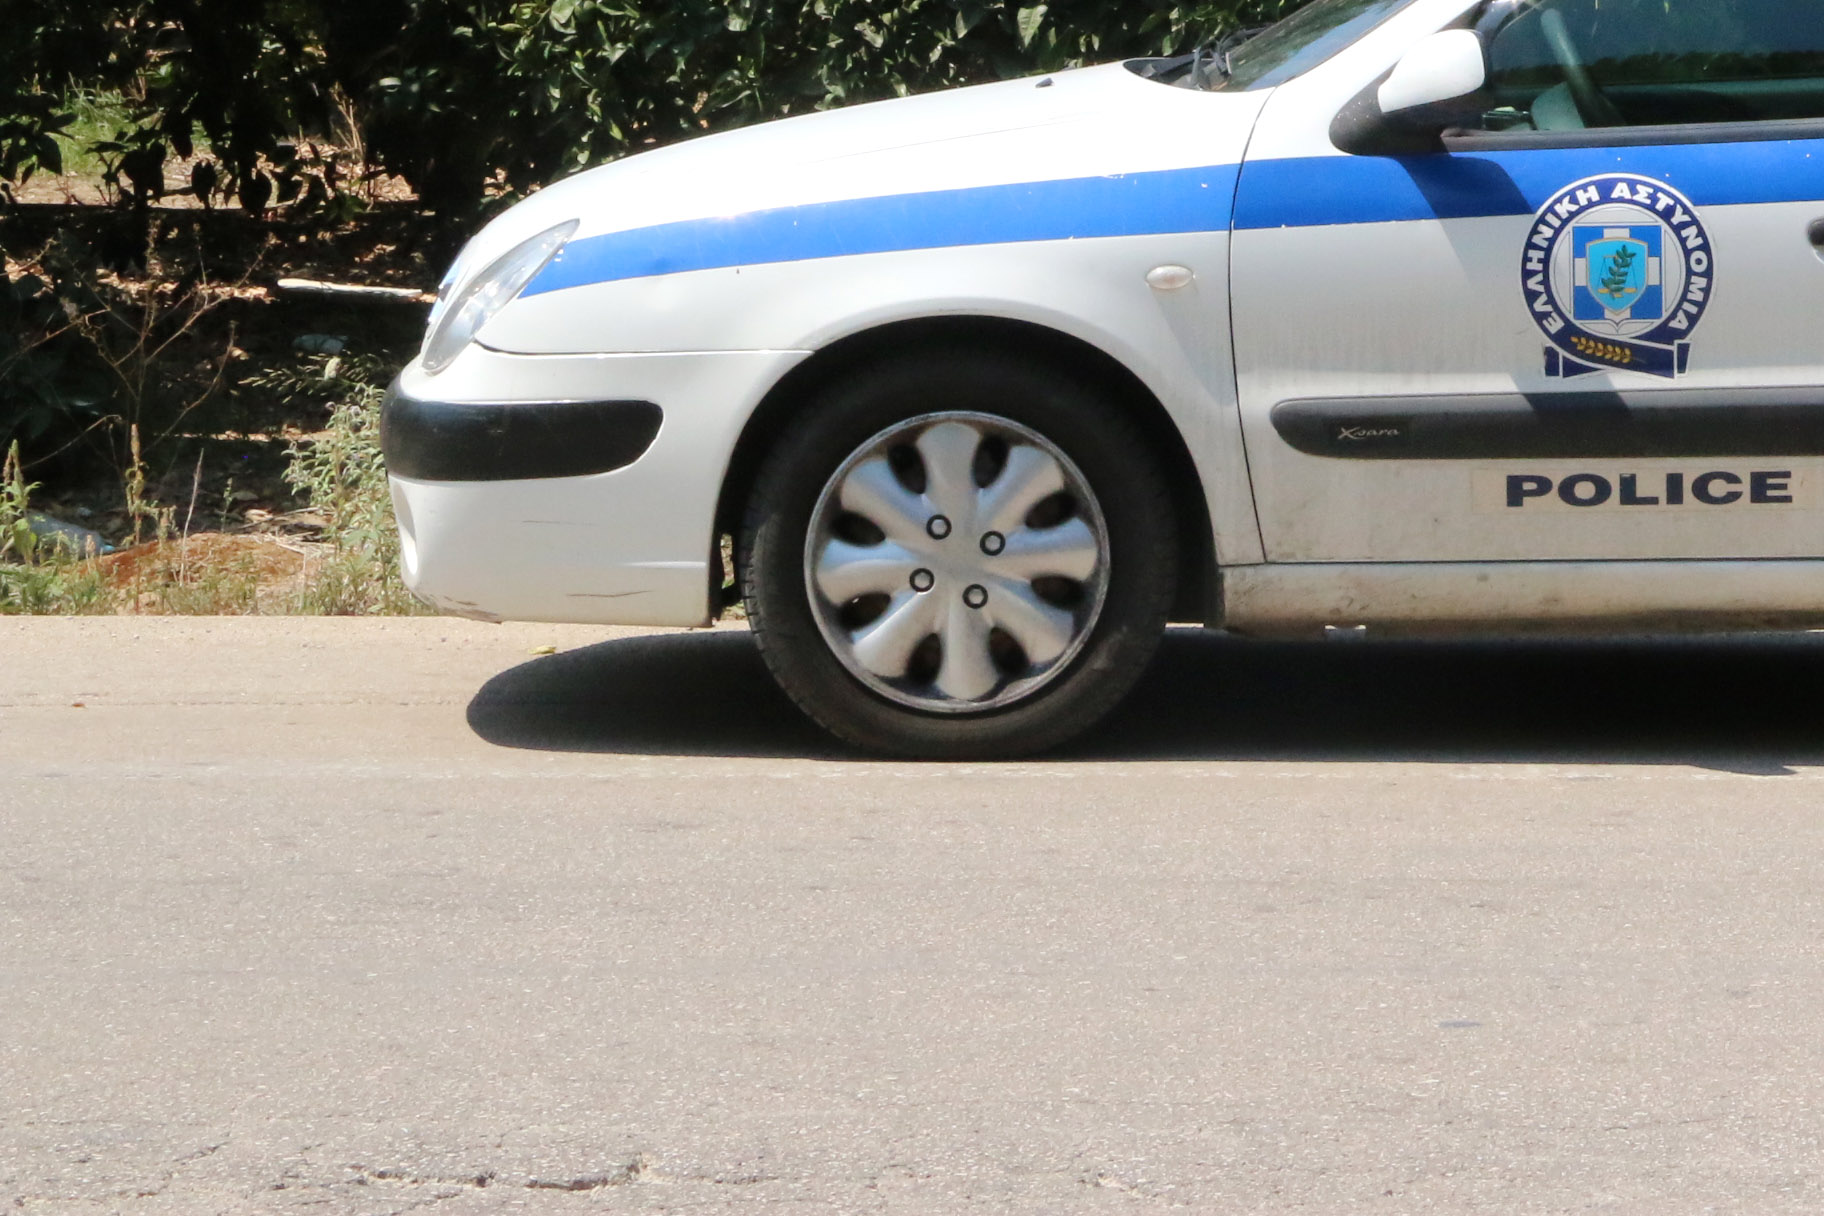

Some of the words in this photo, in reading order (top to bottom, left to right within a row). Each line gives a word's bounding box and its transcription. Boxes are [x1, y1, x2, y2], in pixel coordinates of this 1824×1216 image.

[1523, 185, 1600, 334] ΕΛΛΗΝΙΚΗ
[1611, 182, 1708, 331] ΑΣΤΥΝΟΜΙΑ
[1338, 426, 1400, 440] Xsara
[1506, 471, 1793, 508] POLICE
